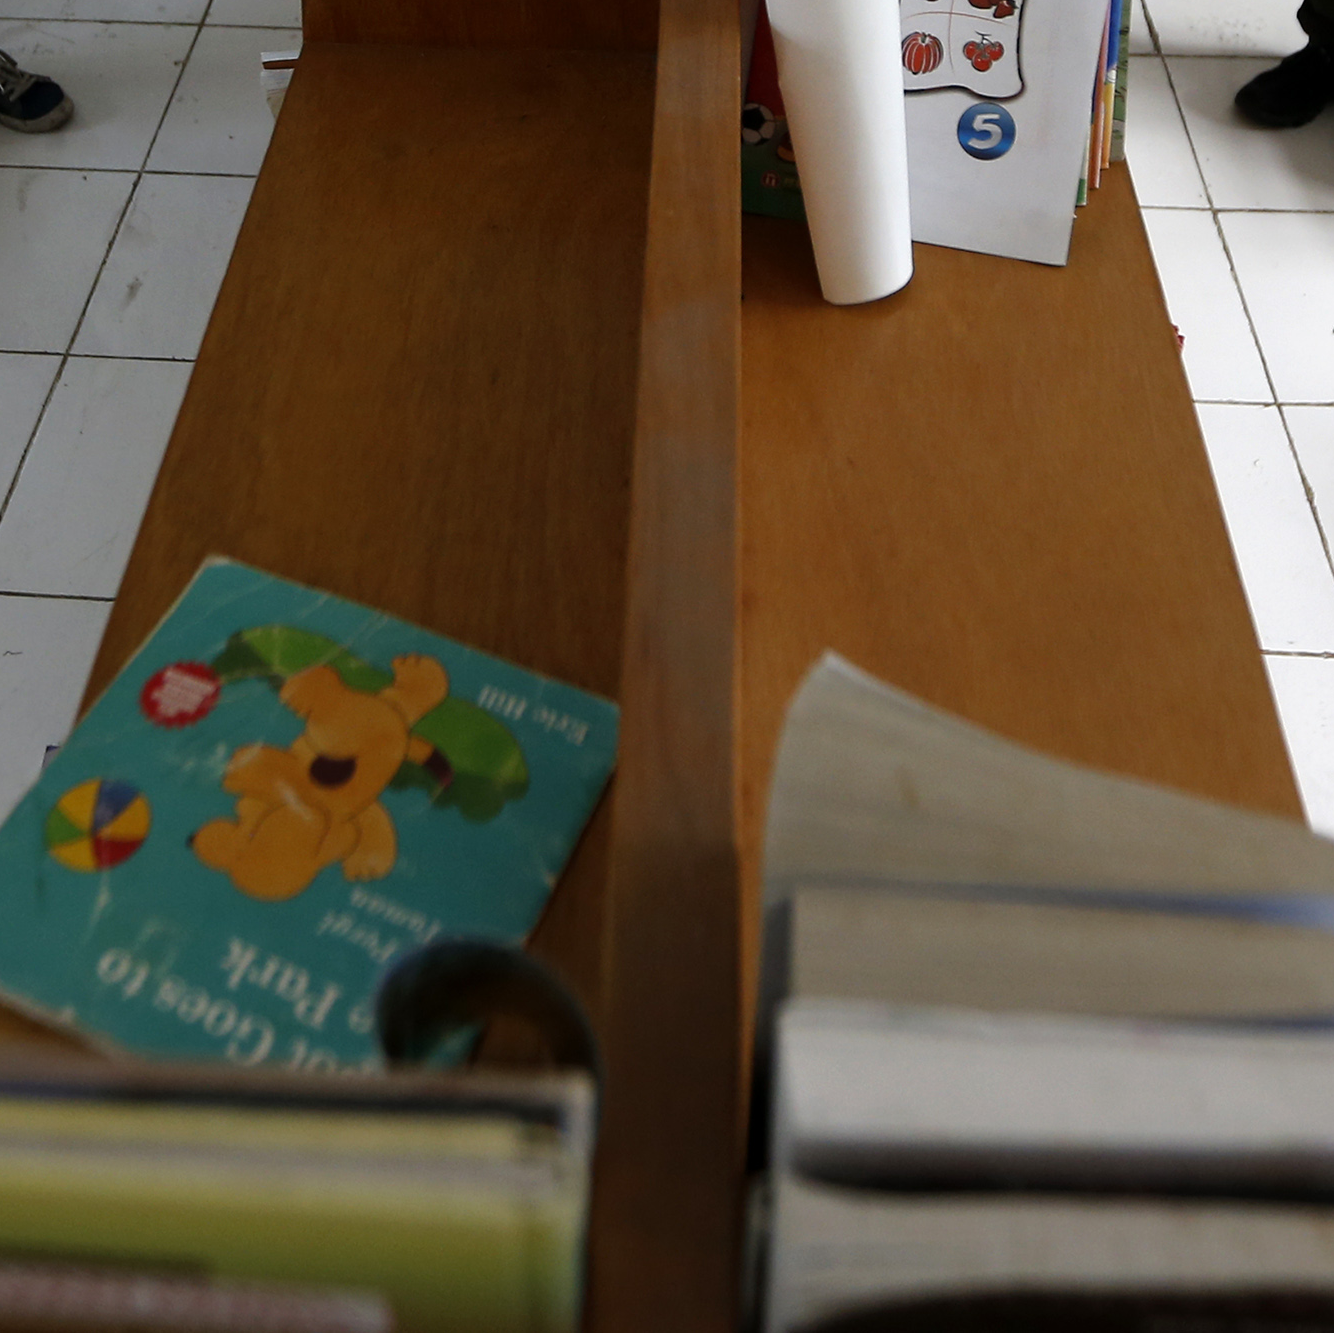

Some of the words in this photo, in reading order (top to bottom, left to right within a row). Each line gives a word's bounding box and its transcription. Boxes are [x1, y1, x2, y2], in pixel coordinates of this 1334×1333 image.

[967, 112, 1002, 150] 5
[96, 947, 150, 1002] to
[220, 936, 343, 1030] Park
[153, 974, 275, 1068] Goes
